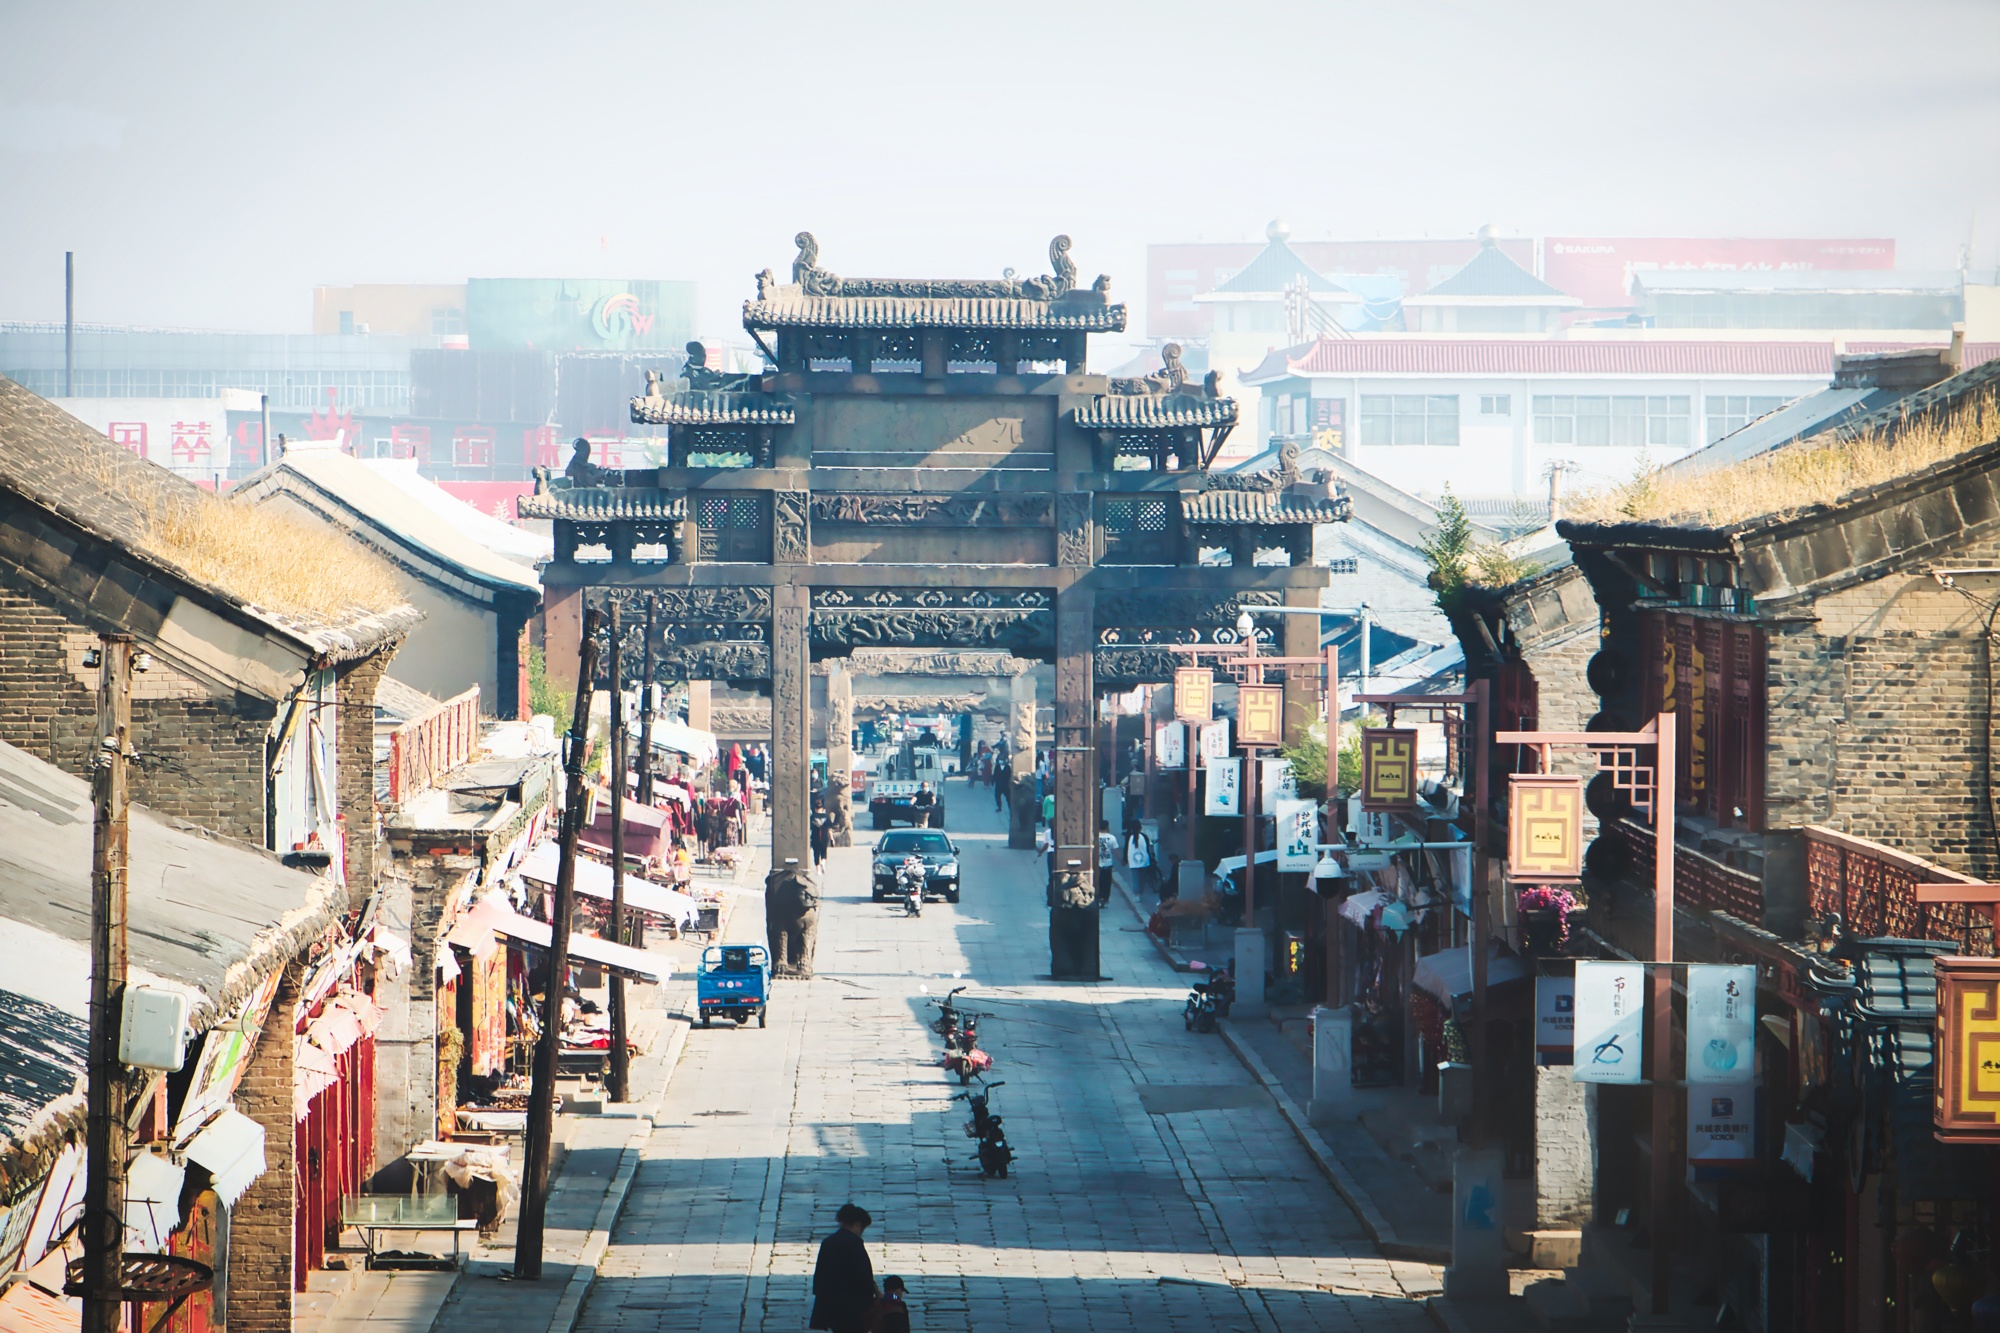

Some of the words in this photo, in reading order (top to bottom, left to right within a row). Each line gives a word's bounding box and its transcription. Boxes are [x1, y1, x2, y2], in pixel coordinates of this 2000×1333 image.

[1565, 245, 1616, 255] SAKURA
[1613, 976, 1625, 1016] 节约粮食
[1725, 979, 1740, 1019] 光盘行动
[1541, 1016, 1575, 1024] 兴城农商
[1695, 1124, 1749, 1133] 兴城农商银行
